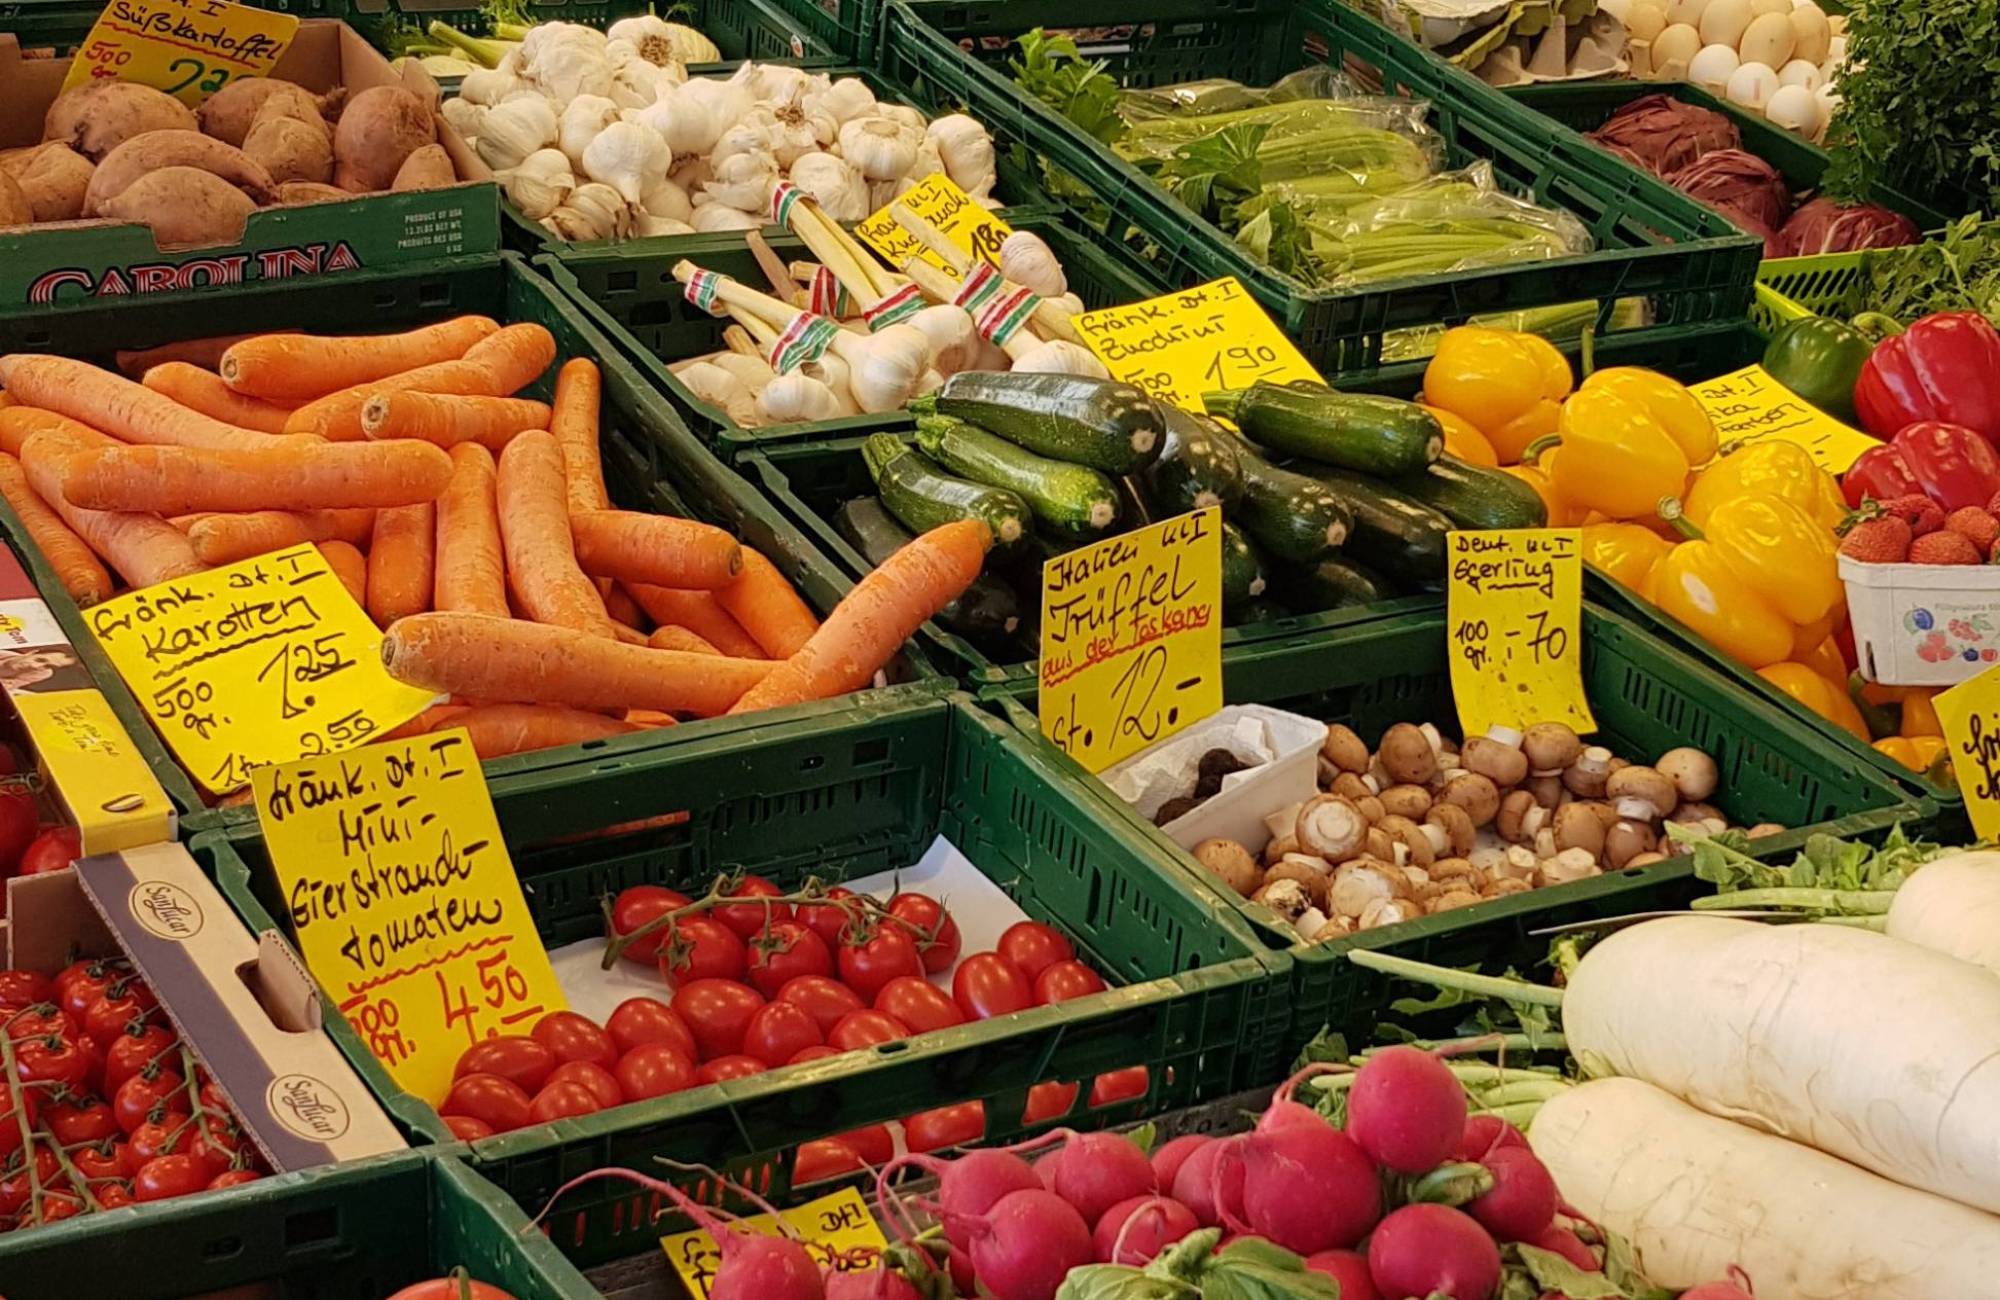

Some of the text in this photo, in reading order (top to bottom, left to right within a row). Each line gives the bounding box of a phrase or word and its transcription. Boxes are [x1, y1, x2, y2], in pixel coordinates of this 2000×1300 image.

[85, 41, 132, 66] 500
[27, 241, 366, 304] CAROLINA
[1099, 314, 1225, 361] Zucchini
[1049, 554, 1197, 643] Trüffel
[1453, 558, 1554, 600] Egerling
[142, 595, 321, 663] Karotten
[1454, 619, 1490, 645] 100
[1042, 650, 1074, 680] aus
[1085, 631, 1119, 662] der
[153, 676, 214, 719] 500
[143, 885, 192, 935] SanLucar
[281, 1079, 337, 1136] SanLucar
